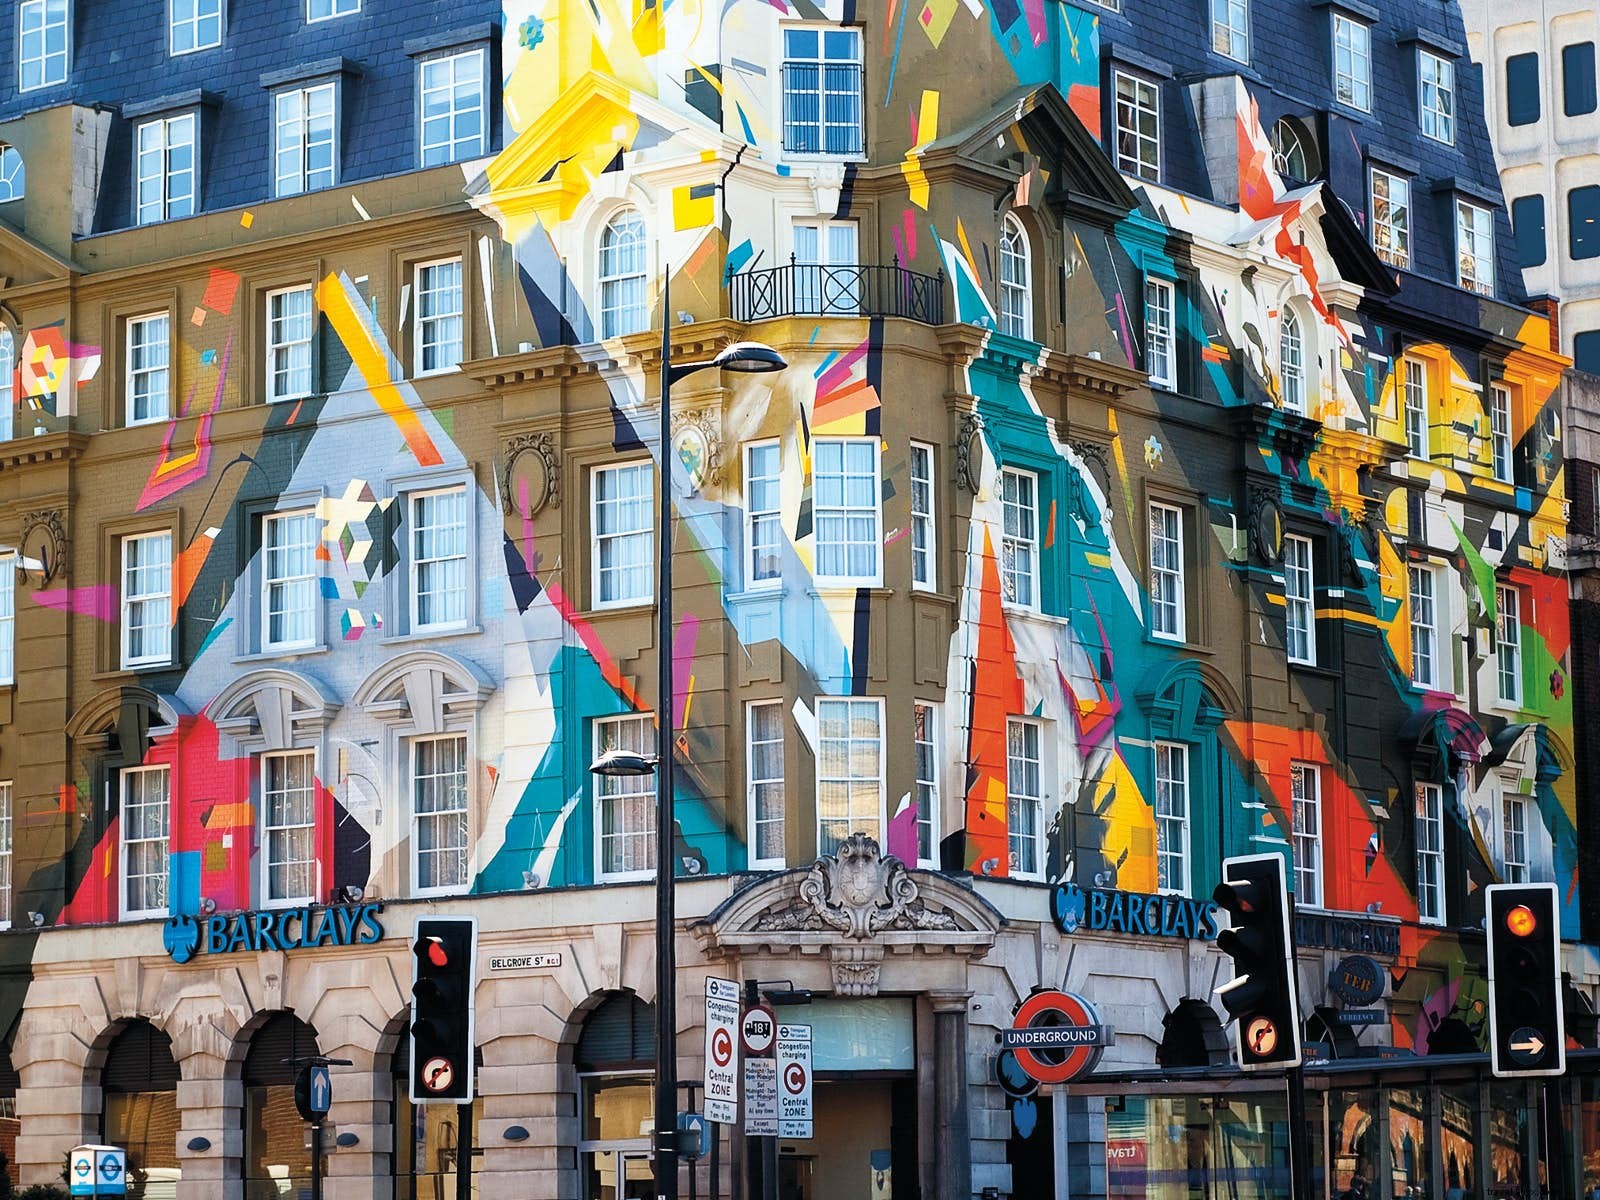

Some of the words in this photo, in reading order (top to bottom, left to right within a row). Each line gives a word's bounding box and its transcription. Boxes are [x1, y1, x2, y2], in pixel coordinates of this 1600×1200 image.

[1091, 891, 1218, 940] BARCLAYS
[207, 905, 384, 954] BARCLAYS
[492, 957, 532, 968] BELGROVE
[707, 1000, 738, 1014] Congestion
[710, 1012, 734, 1025] charging
[1007, 1030, 1097, 1044] UNDERGROUND
[778, 1042, 810, 1052] Congestion
[781, 1051, 807, 1060] charging
[708, 1069, 734, 1084] Central
[711, 1084, 731, 1096] ZONE
[782, 1097, 808, 1107] Central
[784, 1108, 806, 1117] ZONE
